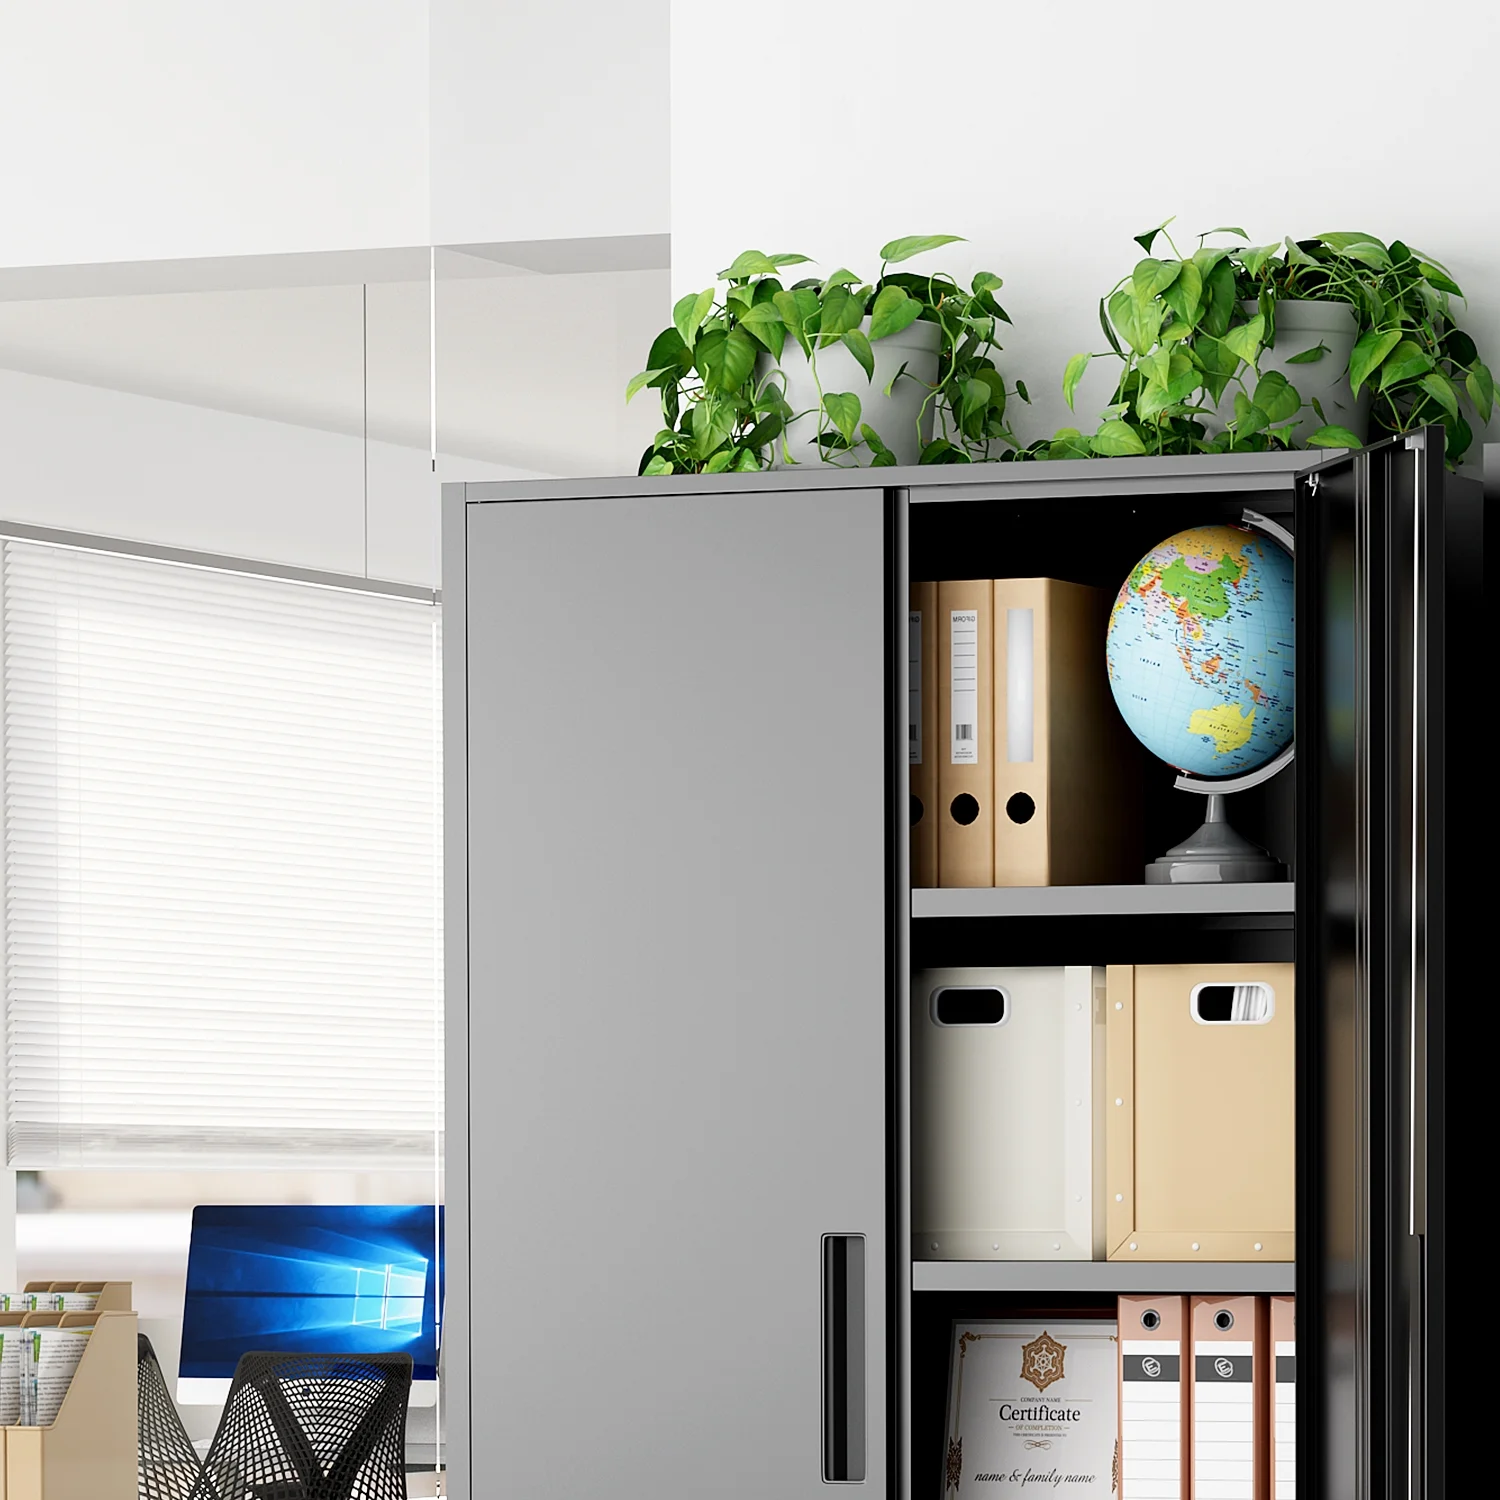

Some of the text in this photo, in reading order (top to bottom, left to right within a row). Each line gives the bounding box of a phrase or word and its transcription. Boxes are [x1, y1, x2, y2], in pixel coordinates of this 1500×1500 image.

[999, 1404, 1081, 1421] Certificate
[974, 1468, 1097, 1488] name & family name
